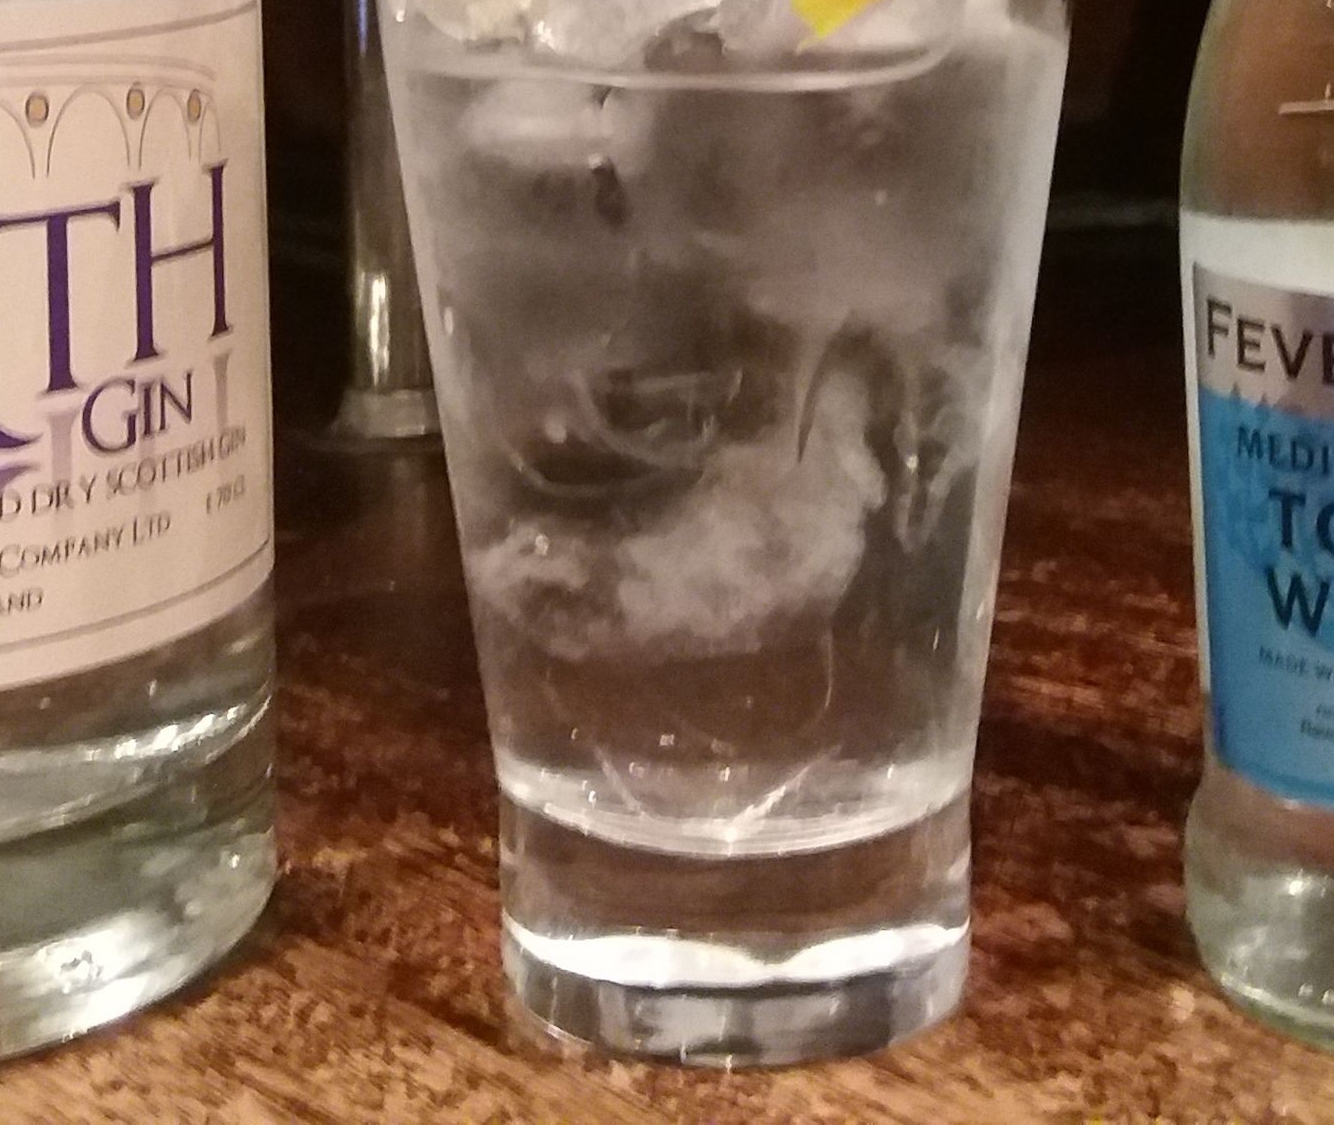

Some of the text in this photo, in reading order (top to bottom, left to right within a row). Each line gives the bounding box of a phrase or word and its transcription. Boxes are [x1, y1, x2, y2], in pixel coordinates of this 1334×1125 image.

[82, 370, 192, 456] GIN
[31, 475, 98, 516] DRY
[105, 436, 215, 501] SCOTTISH
[131, 510, 171, 546] LTD
[1258, 645, 1307, 674] MADE
